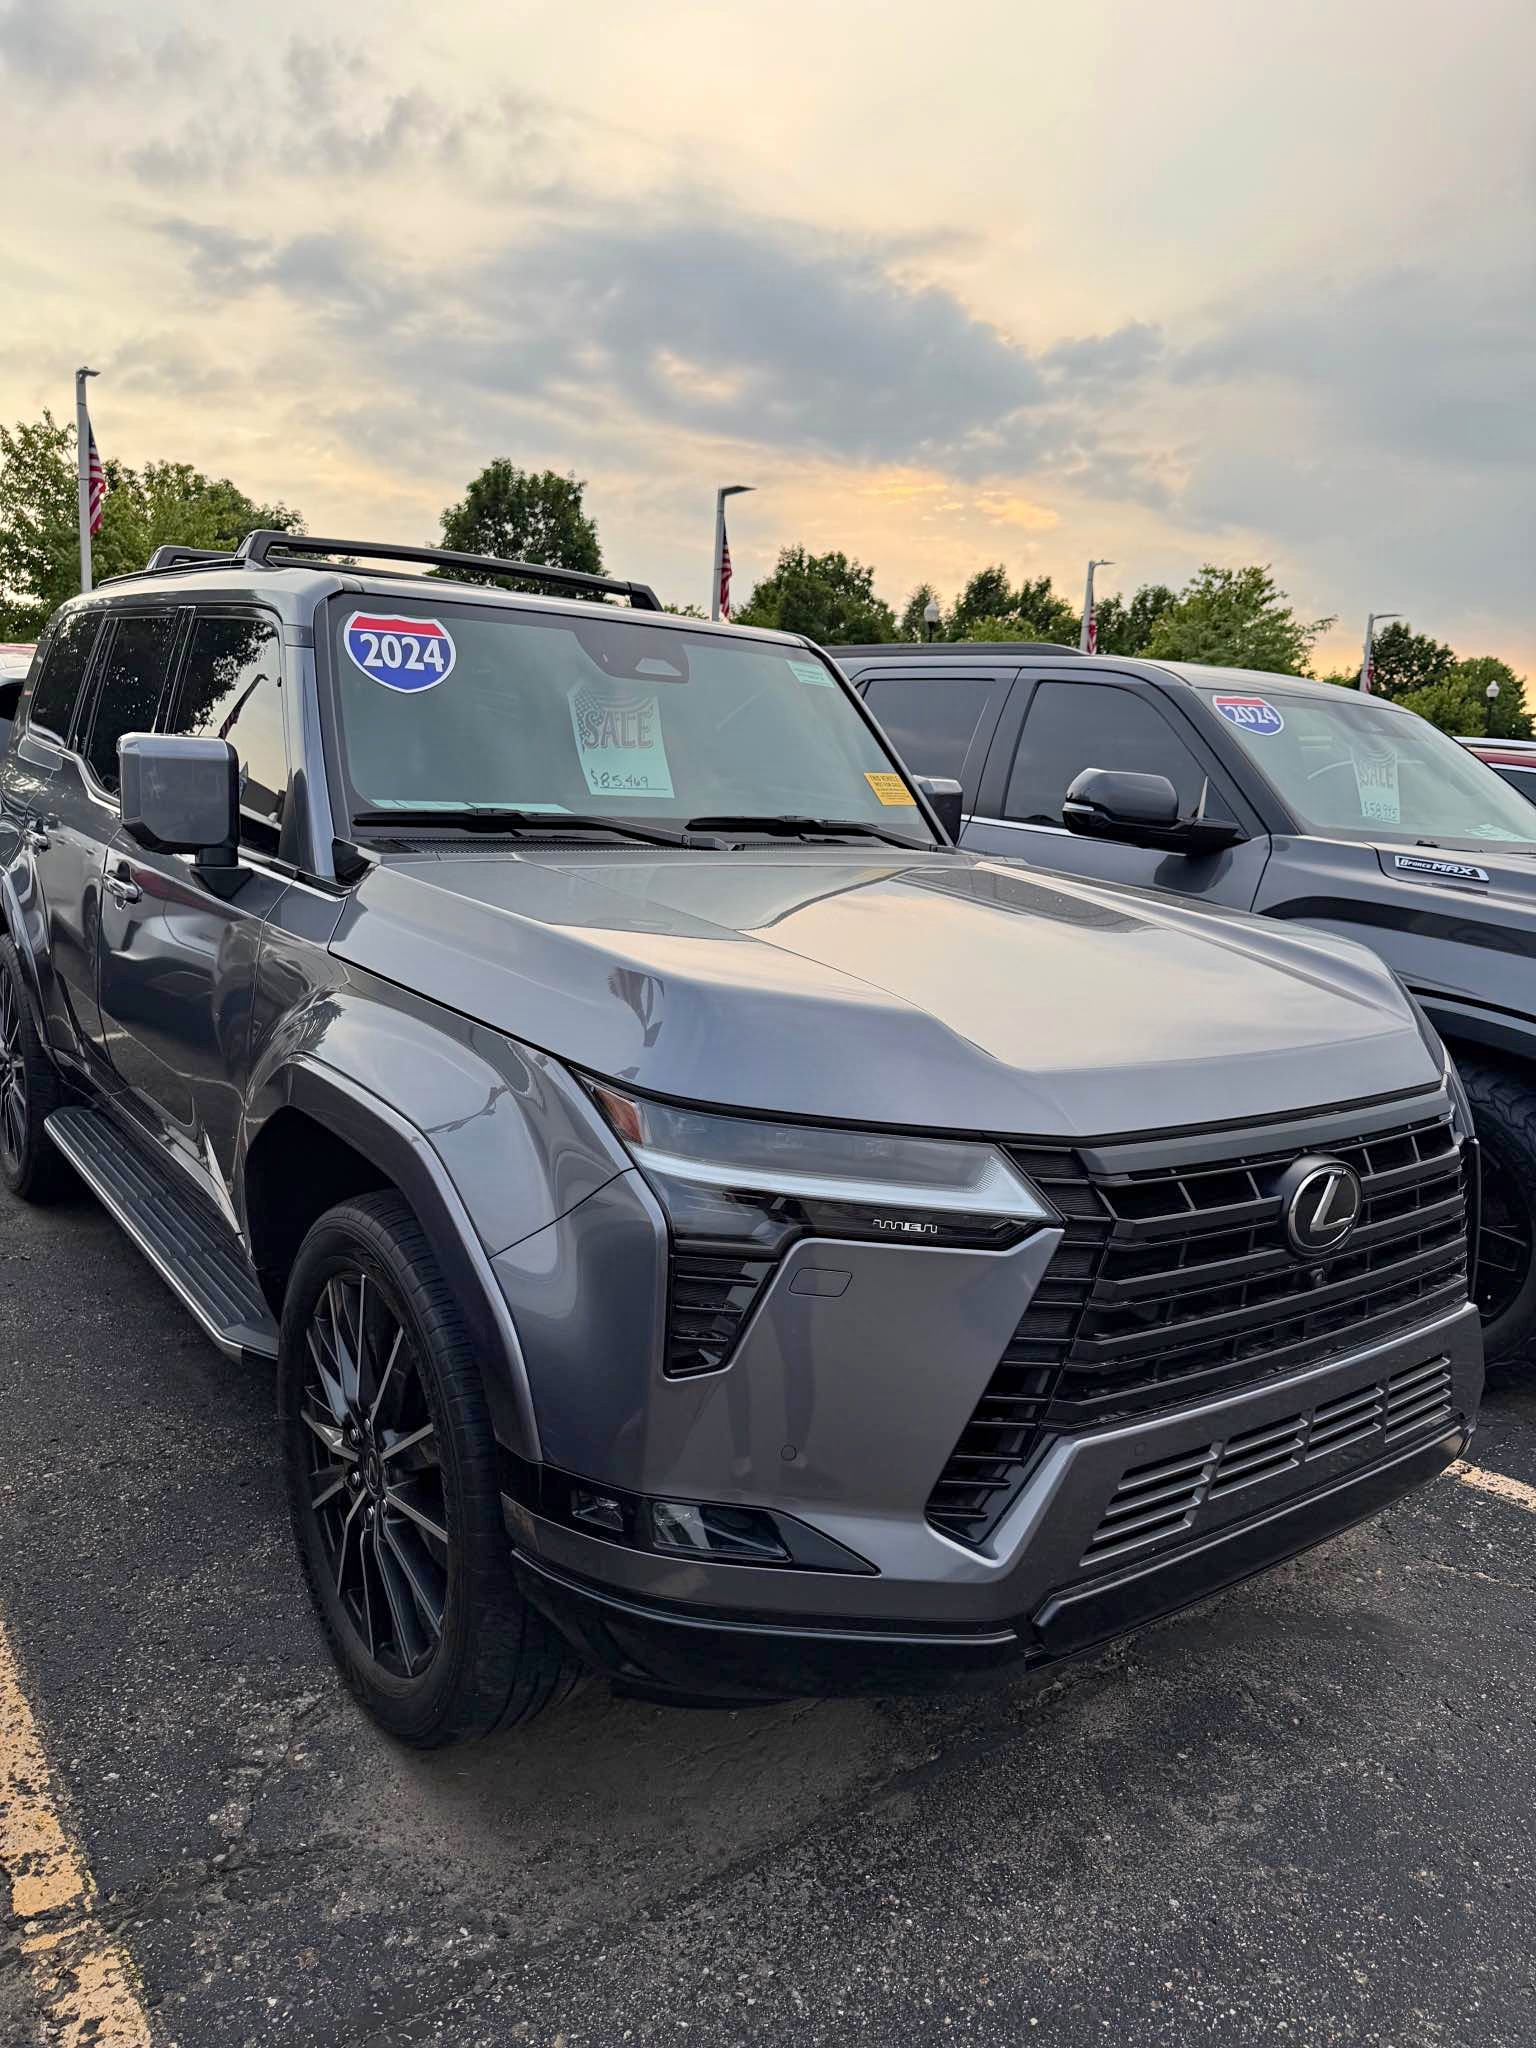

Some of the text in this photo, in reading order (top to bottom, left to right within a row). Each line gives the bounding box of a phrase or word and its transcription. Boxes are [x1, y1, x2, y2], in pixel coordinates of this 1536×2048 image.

[360, 632, 445, 673] 2024
[583, 707, 655, 749] SALE
[1224, 705, 1280, 725] 2024
[1432, 863, 1473, 876] MAX
